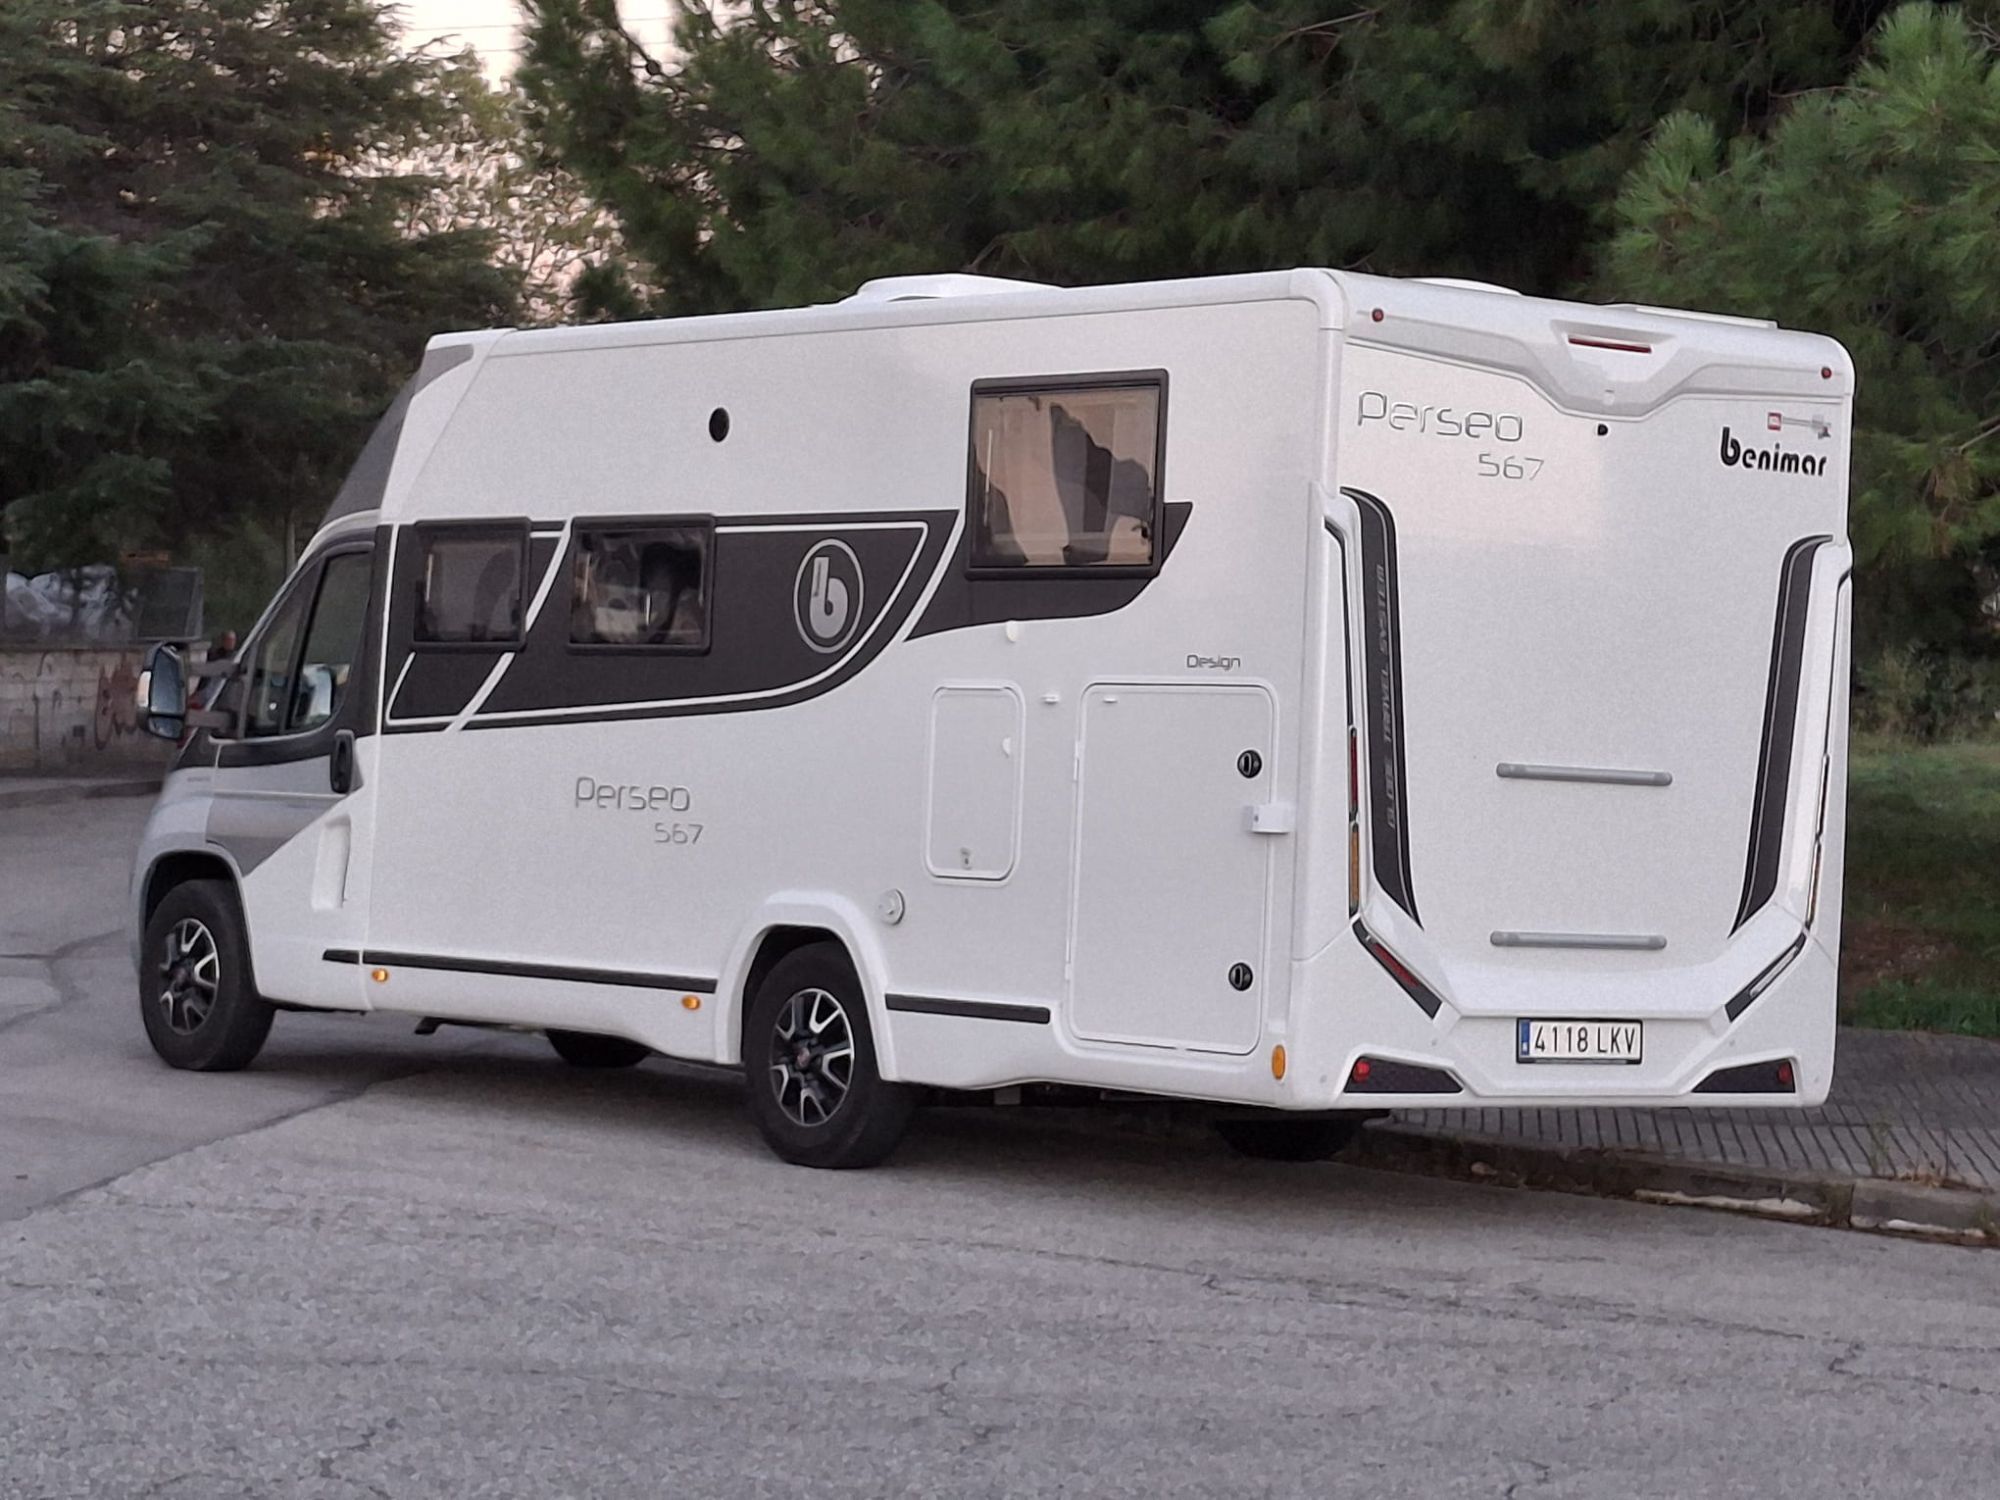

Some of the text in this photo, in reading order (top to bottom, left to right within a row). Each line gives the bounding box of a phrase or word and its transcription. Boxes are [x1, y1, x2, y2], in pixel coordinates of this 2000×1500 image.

[1357, 391, 1523, 442] Perseo
[1478, 453, 1545, 480] 567
[1720, 426, 1827, 477] benimar
[1376, 563, 1388, 655] SYSTEM
[1186, 654, 1241, 672] Design
[575, 776, 690, 811] Perseo
[654, 822, 704, 844] 567
[1534, 1025, 1635, 1054] 4118 LKV
